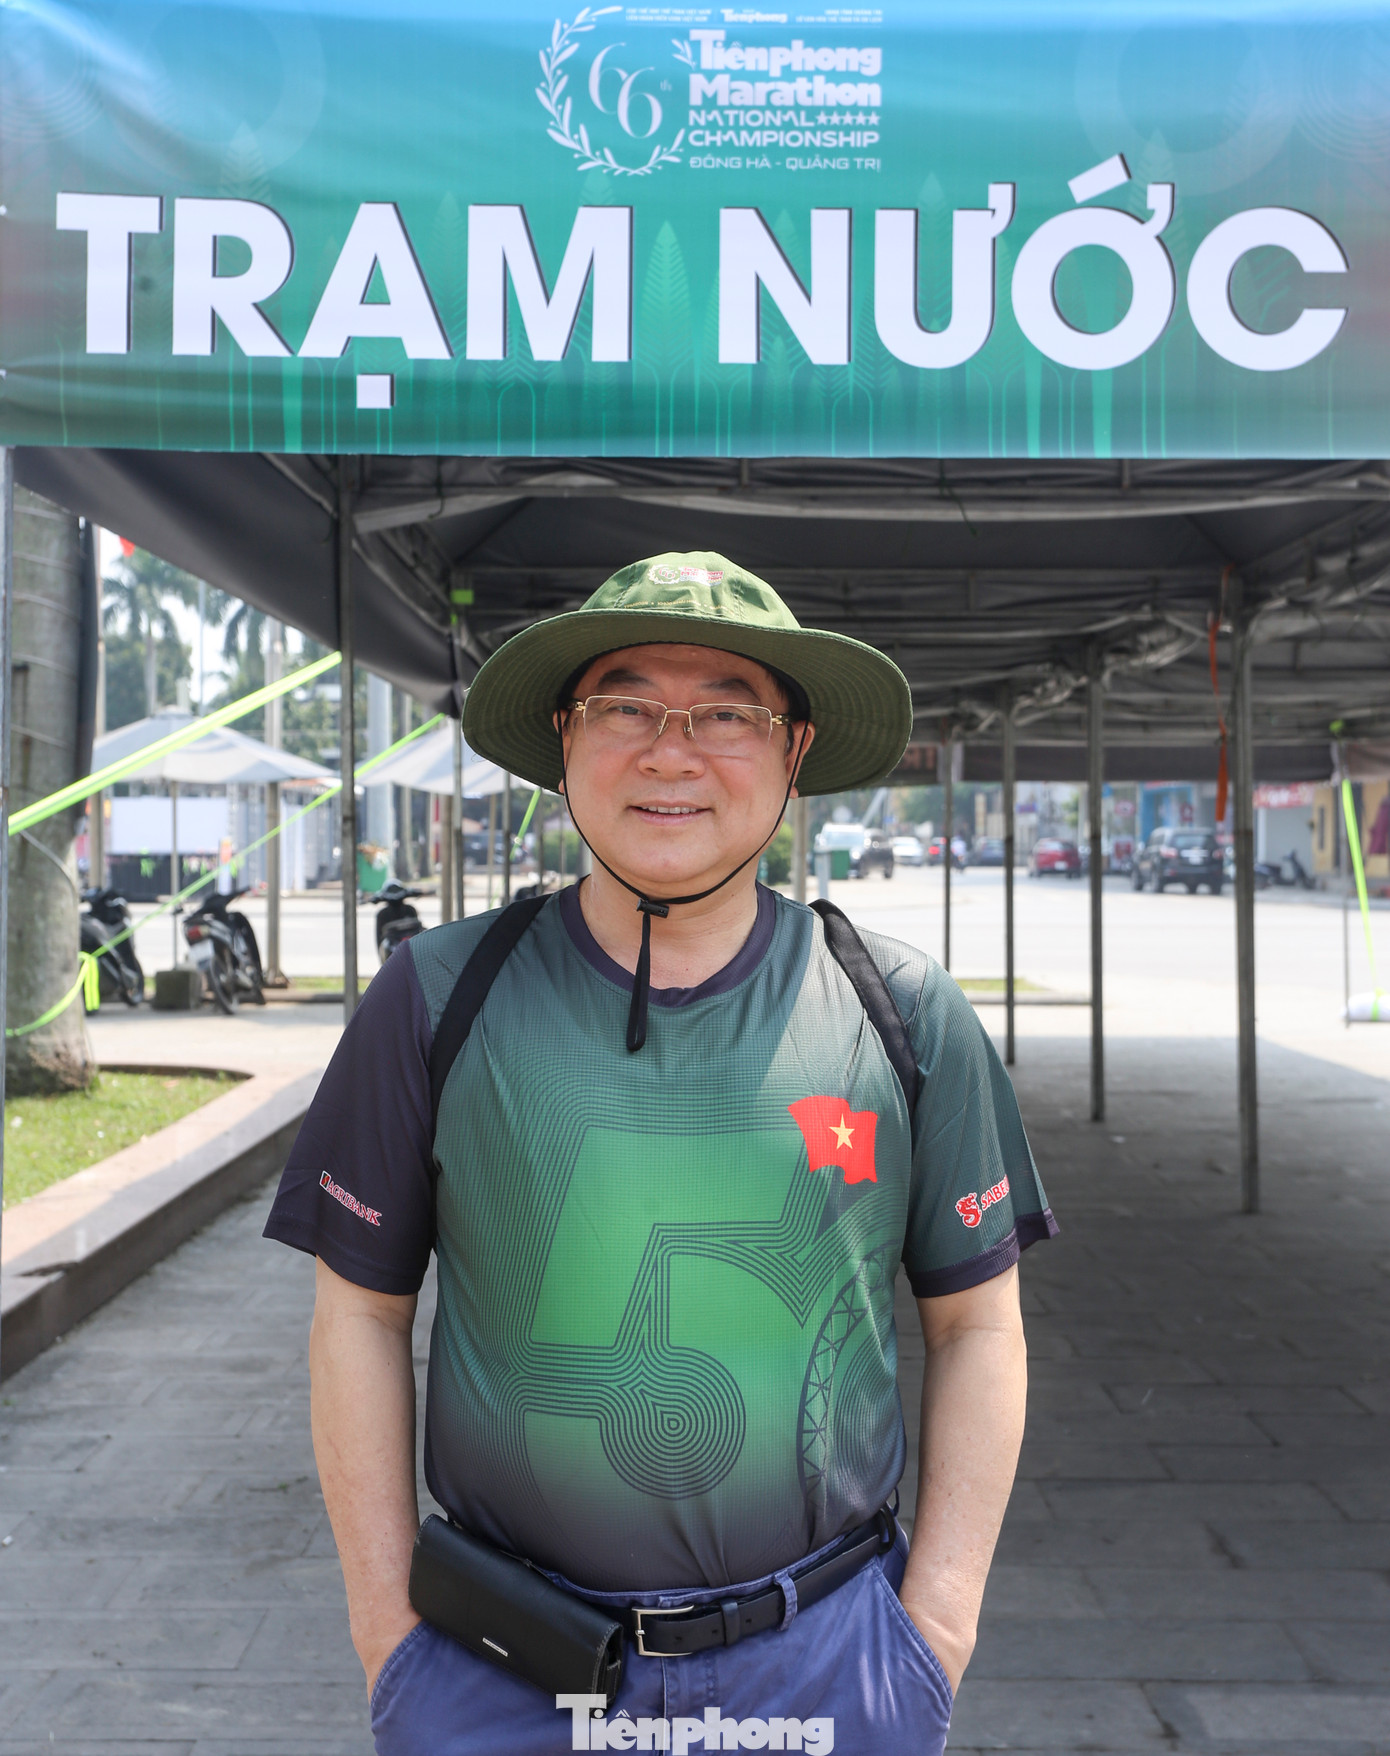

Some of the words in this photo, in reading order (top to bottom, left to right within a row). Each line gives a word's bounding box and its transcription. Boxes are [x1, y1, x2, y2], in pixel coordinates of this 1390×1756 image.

[689, 73, 881, 107] Marathon
[688, 109, 815, 127] NATIONAL
[688, 129, 880, 148] CHAMPIONSHIP
[689, 153, 742, 169] ĐÔNG
[746, 153, 772, 169] HÀ
[786, 153, 849, 171] QUẢNG
[853, 156, 881, 173] TRỊ
[56, 191, 634, 410] TRẠM
[718, 152, 1350, 372] NƯỚC
[326, 1180, 383, 1227] AGRIBANK
